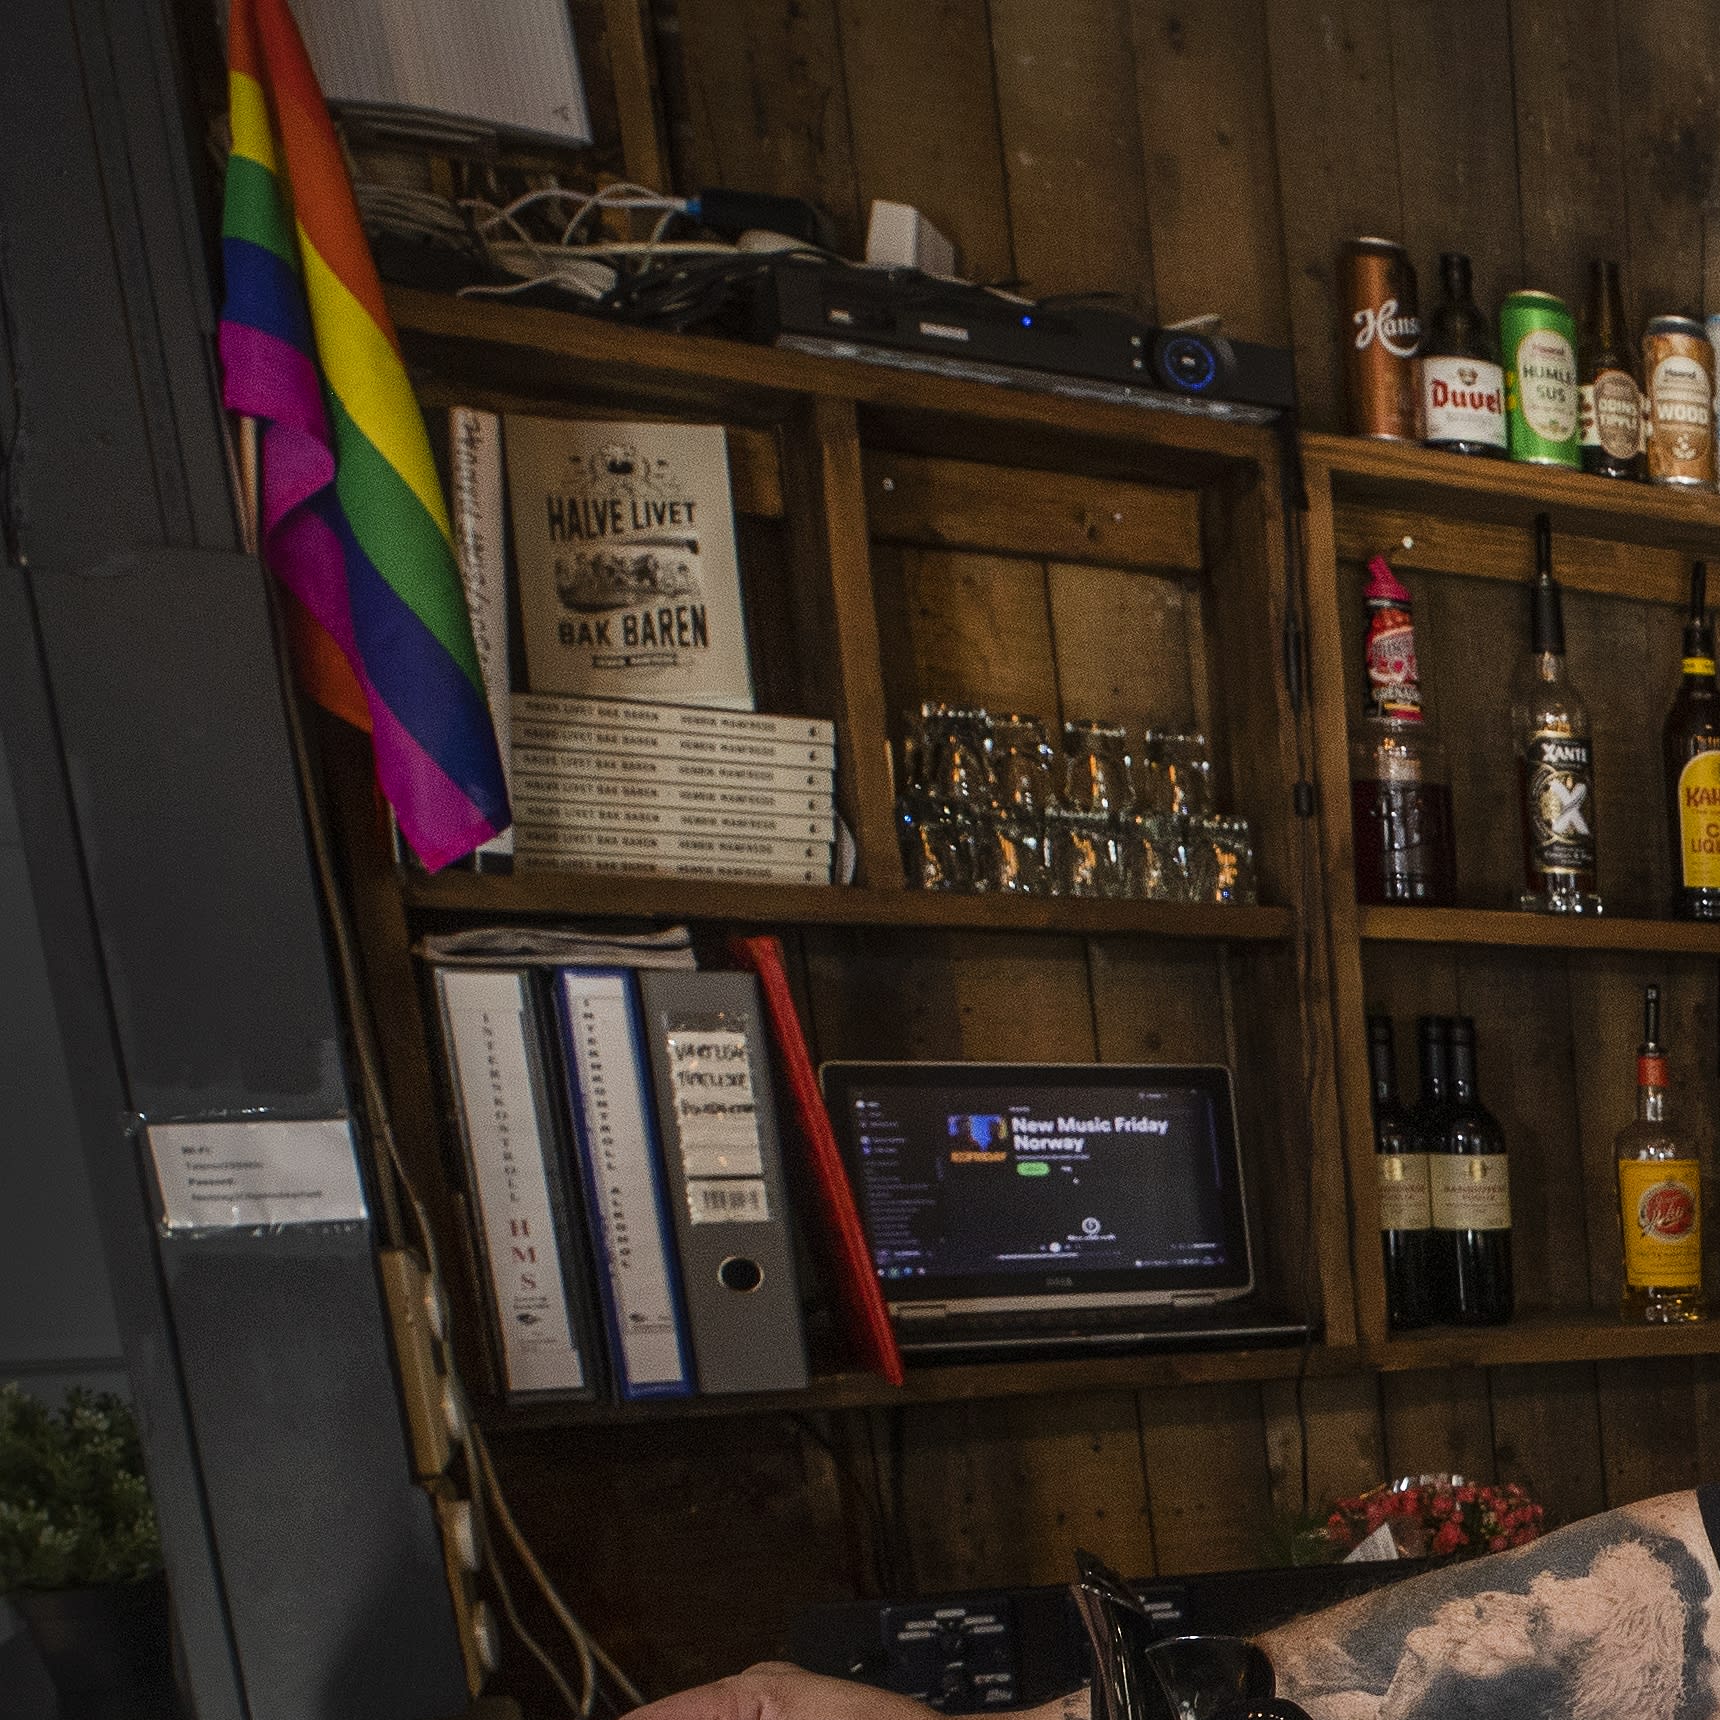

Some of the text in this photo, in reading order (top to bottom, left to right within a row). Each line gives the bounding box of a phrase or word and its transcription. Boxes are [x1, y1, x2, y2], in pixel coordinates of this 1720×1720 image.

[1432, 379, 1502, 414] Duvel
[547, 496, 697, 542] HALVE LIVET
[558, 604, 710, 648] BAK BAREN
[1012, 1117, 1169, 1136] New Music Friday
[1014, 1135, 1085, 1152] Norway
